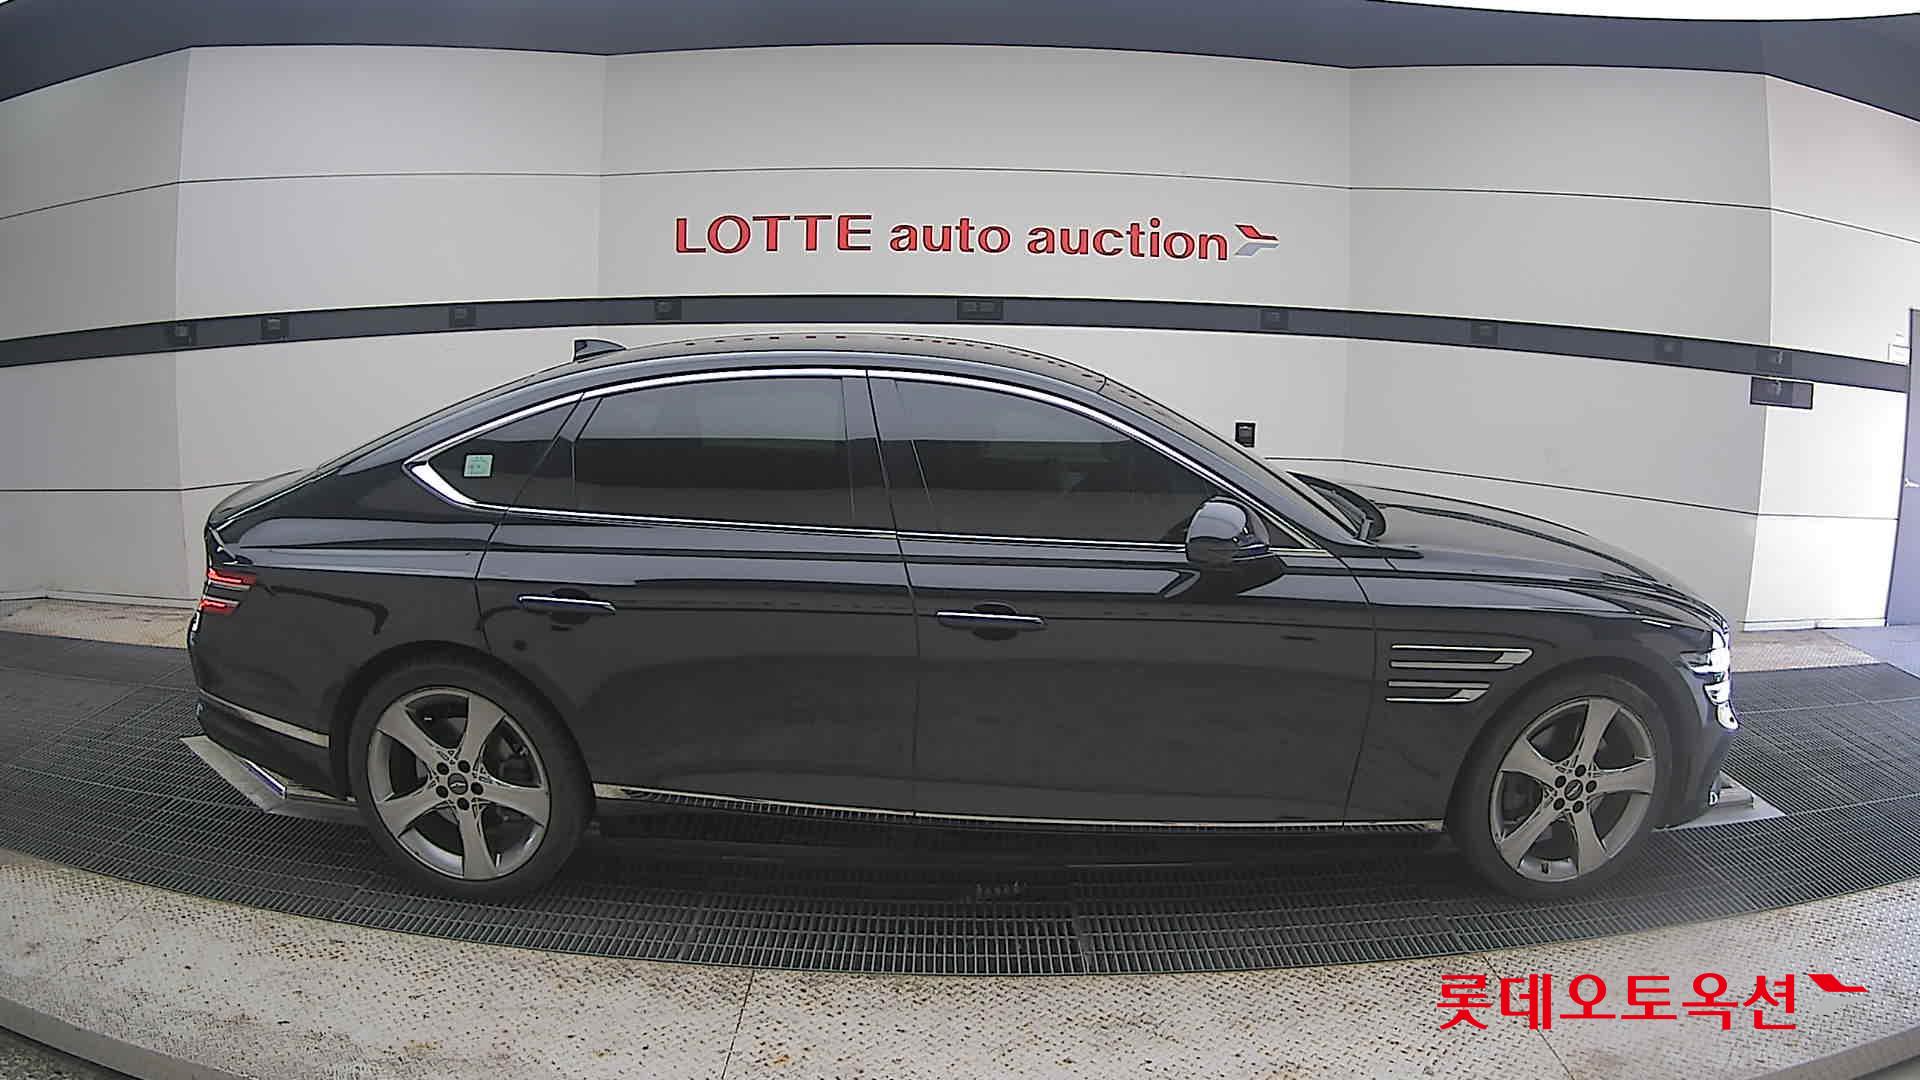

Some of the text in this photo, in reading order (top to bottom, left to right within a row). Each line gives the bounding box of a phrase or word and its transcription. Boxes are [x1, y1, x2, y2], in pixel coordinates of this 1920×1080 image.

[675, 214, 1229, 260] LOTTE auto auction
